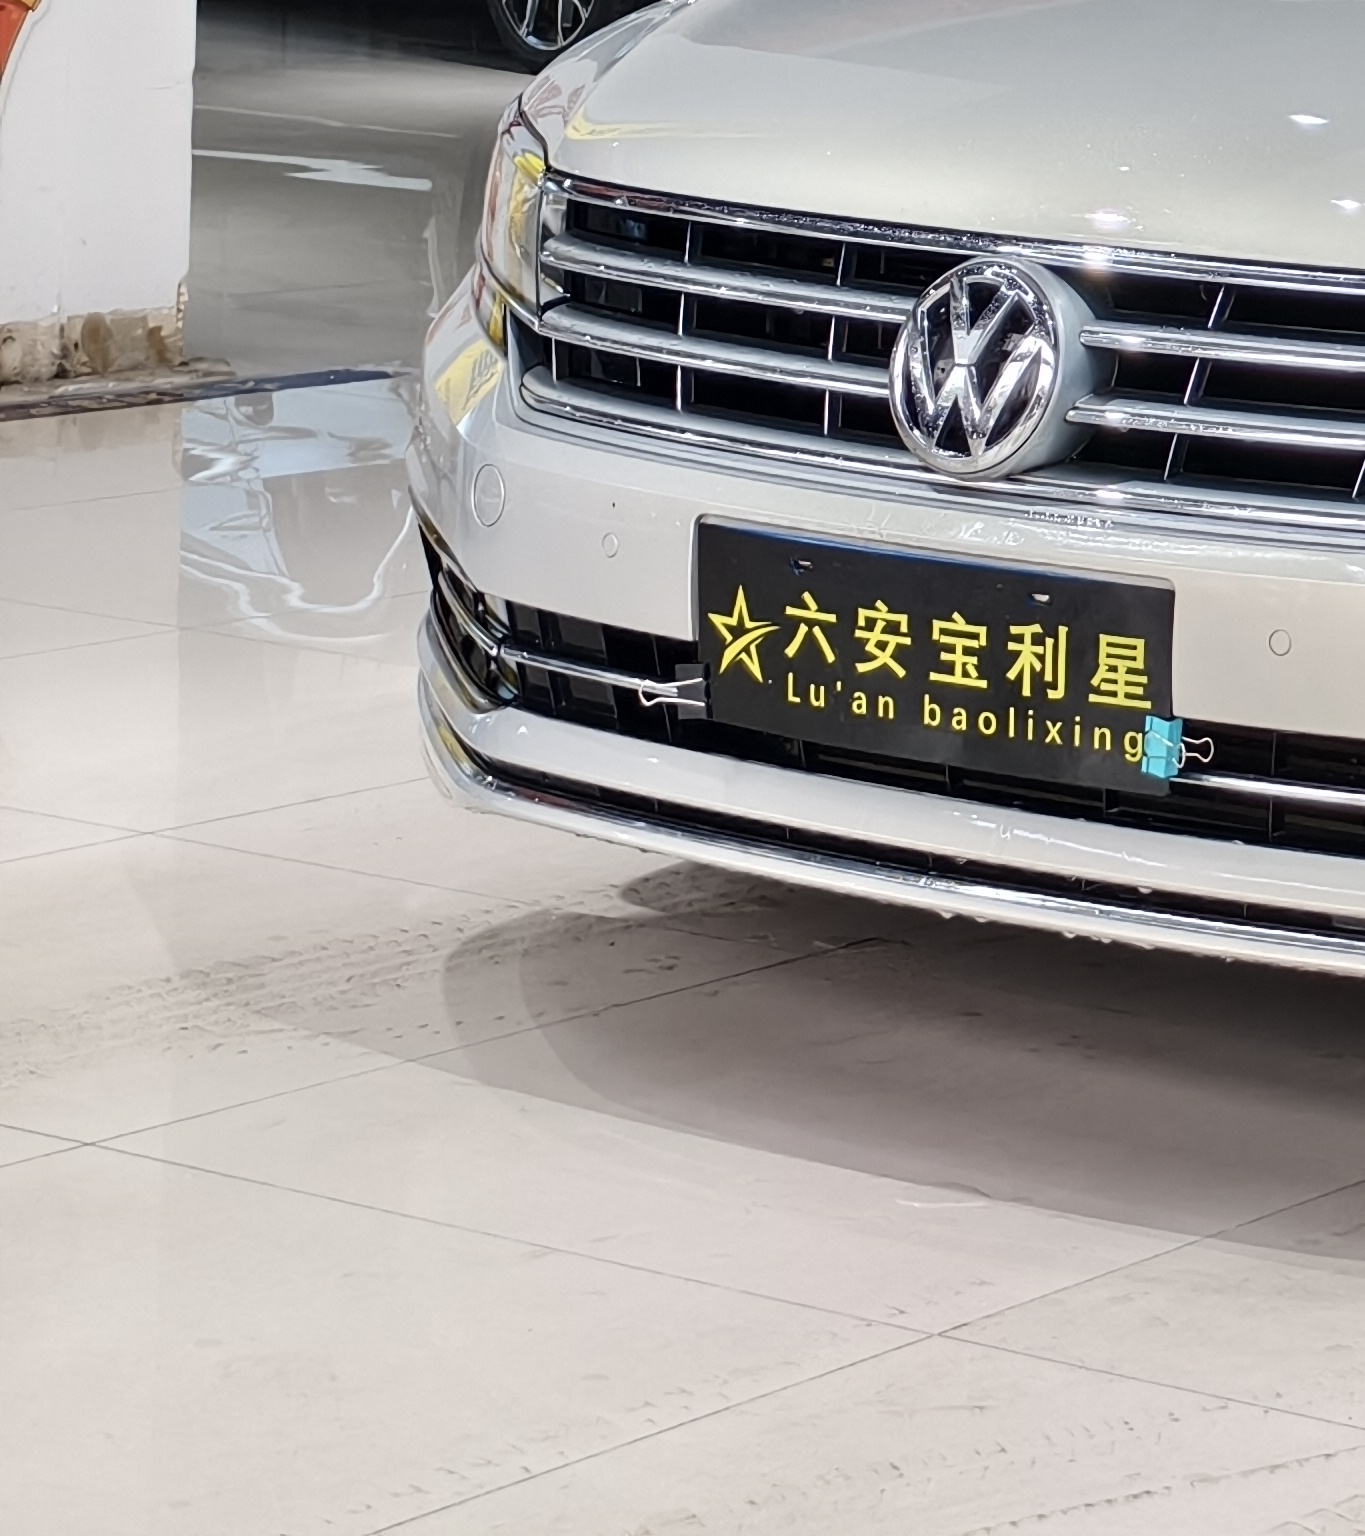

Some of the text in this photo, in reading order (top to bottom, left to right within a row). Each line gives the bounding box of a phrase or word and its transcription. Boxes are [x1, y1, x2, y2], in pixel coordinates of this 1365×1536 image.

[784, 591, 1153, 710] 六安宝利星
[787, 672, 1145, 762] Lu'an baolixing
